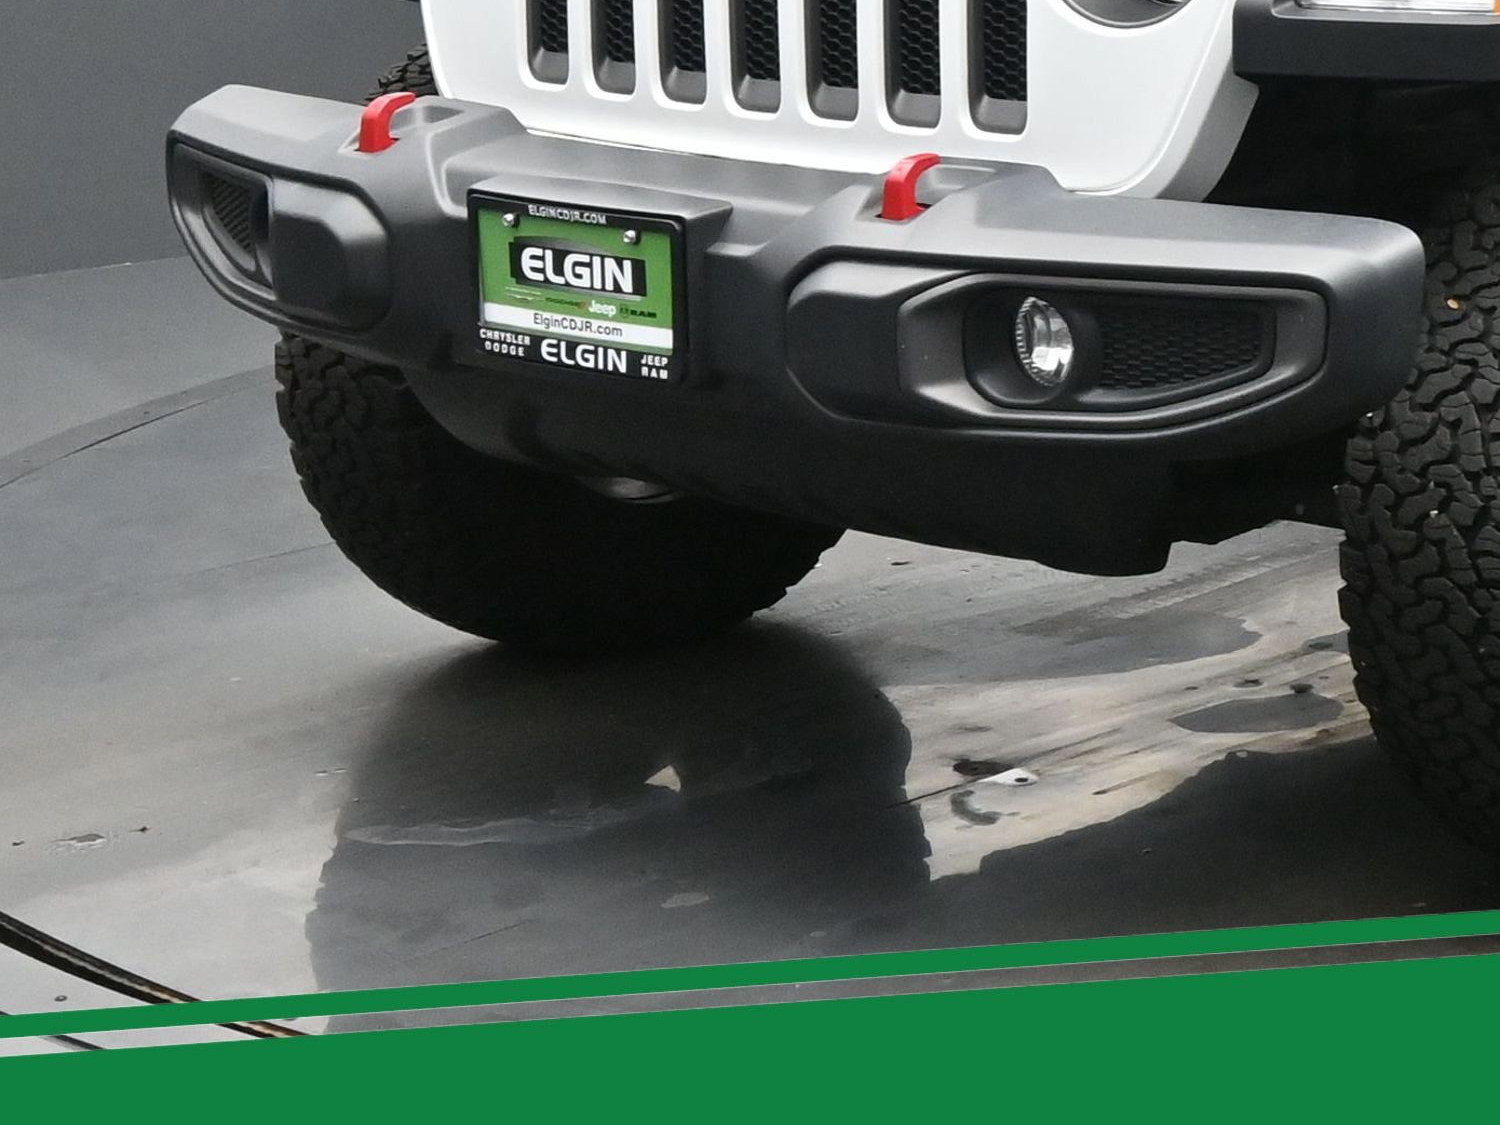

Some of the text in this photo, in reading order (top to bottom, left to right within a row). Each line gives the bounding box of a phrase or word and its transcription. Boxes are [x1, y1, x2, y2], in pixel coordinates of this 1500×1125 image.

[527, 203, 608, 225] ELGINCDJR.COM
[520, 246, 634, 294] ELGIN
[588, 299, 617, 318] Jeep
[532, 312, 624, 338] ElginCDJR.com
[479, 328, 531, 346] CHRYSLER
[484, 341, 526, 357] DODGE
[540, 338, 628, 374] ELGIN
[640, 354, 669, 367] JEEP
[640, 367, 669, 380] RAM
